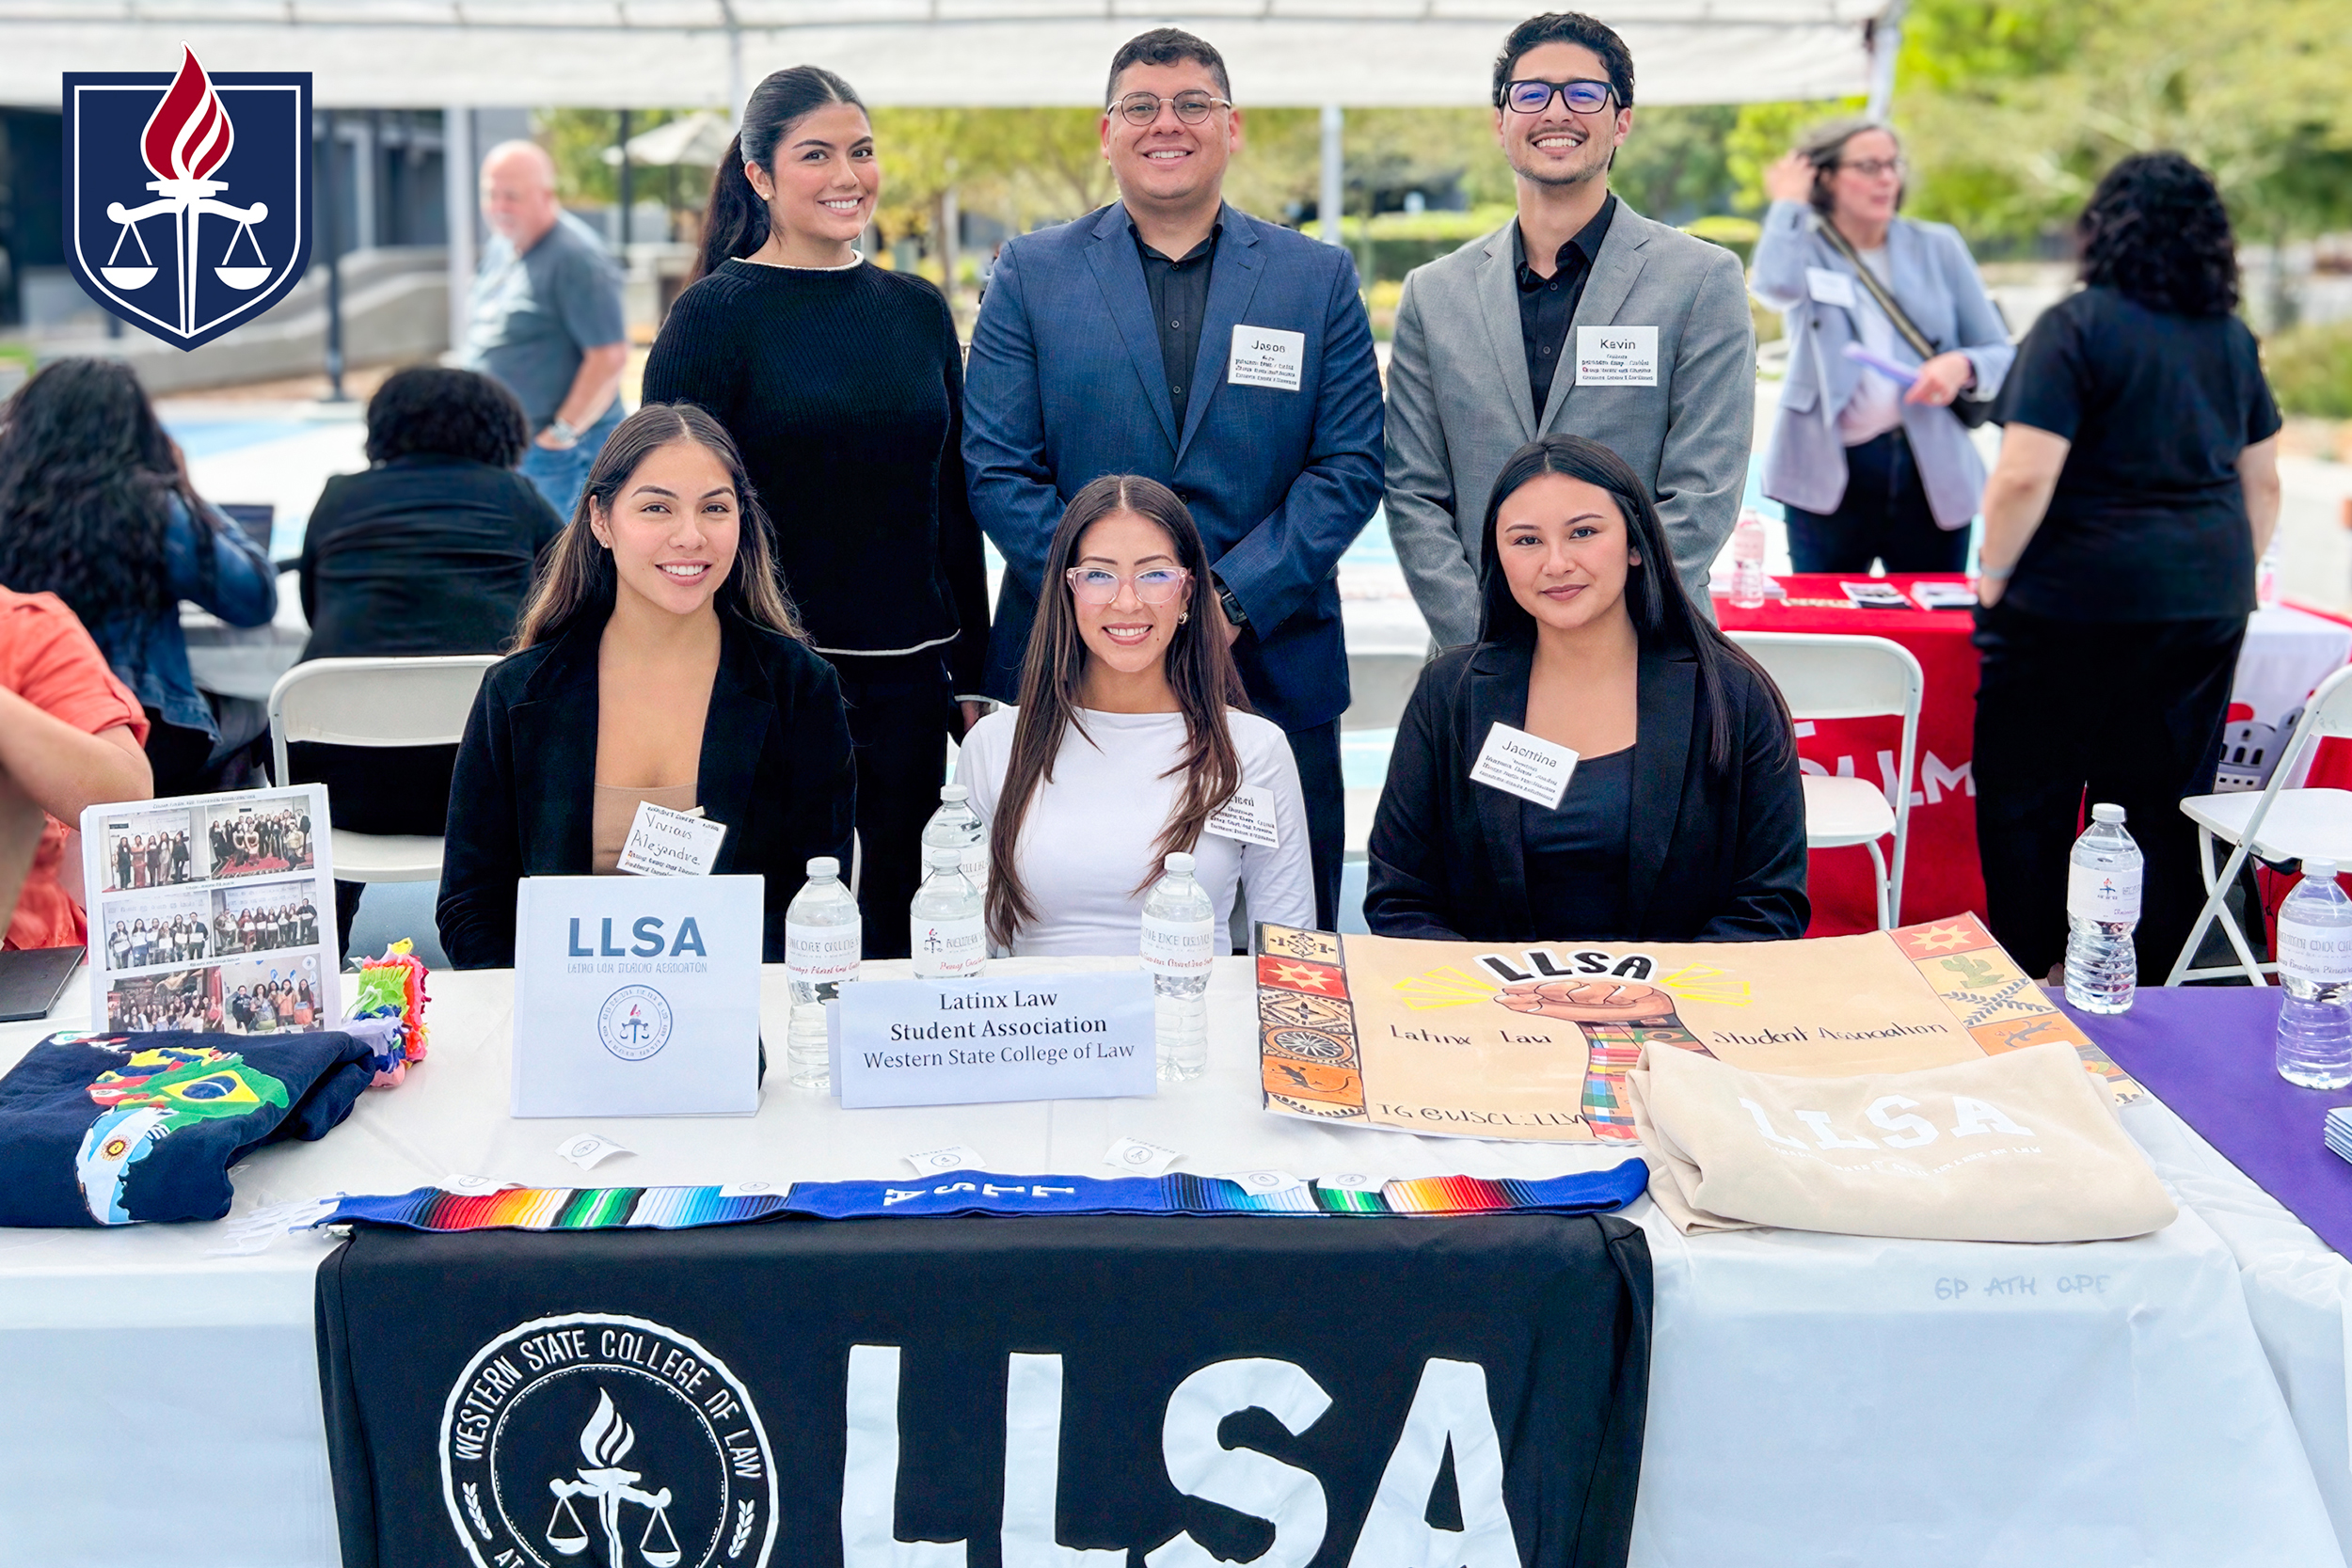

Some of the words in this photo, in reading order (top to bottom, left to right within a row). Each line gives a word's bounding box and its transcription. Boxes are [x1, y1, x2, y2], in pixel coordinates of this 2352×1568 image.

[567, 916, 707, 958] LLSA
[1482, 951, 1653, 983] LLSA
[939, 992, 1009, 1010] Latinx
[1013, 990, 1058, 1008] Law
[890, 1021, 977, 1041] Student
[981, 1016, 1107, 1037] Association
[863, 1050, 943, 1069] Western
[948, 1047, 995, 1065] State
[1001, 1045, 1068, 1066] College
[1073, 1042, 1091, 1059] of
[1097, 1042, 1135, 1059] Law
[1737, 1093, 2036, 1151] LLSA
[454, 1354, 523, 1460] WESTERN
[519, 1329, 590, 1372] STATE
[601, 1329, 711, 1396] COLLEGE
[723, 1428, 762, 1480] LAW
[841, 1343, 1522, 1568] LLSA
